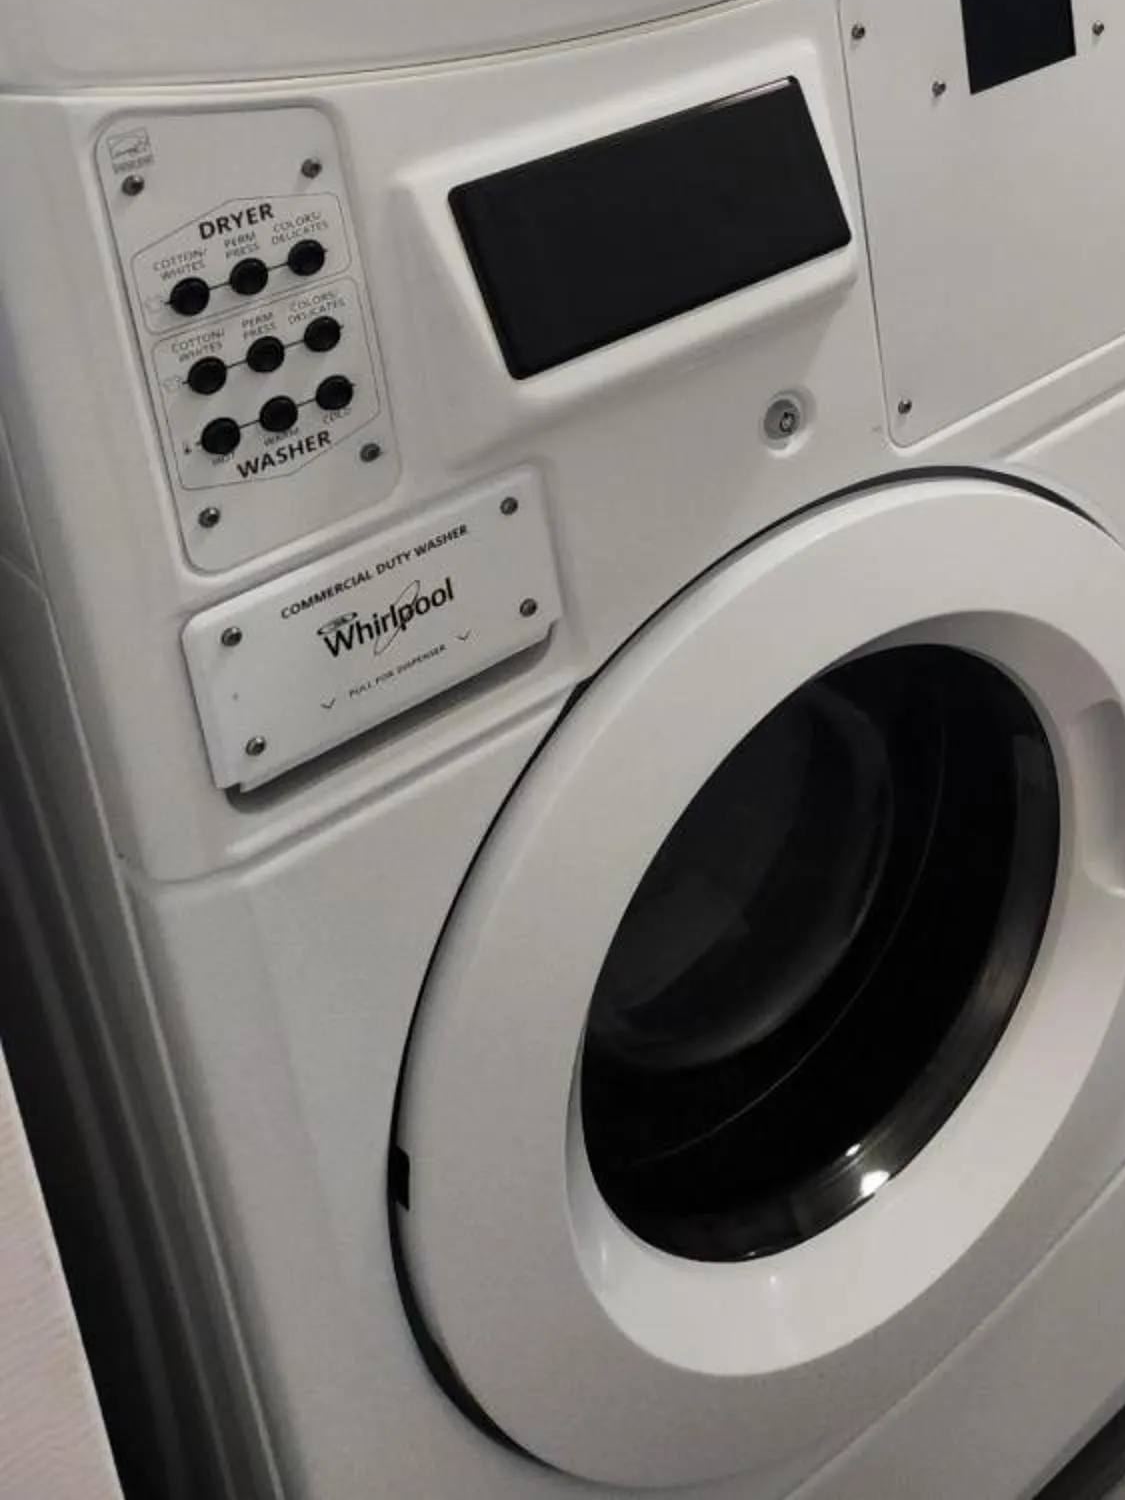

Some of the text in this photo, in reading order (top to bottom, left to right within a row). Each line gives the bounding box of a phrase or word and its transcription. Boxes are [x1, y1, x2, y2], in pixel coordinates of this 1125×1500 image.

[198, 202, 275, 241] DRYER
[223, 231, 256, 249] PERM
[236, 429, 332, 480] WASHER
[280, 524, 467, 620] COMMERCIAL DUTY WASHER
[322, 576, 455, 658] Whirlpool
[349, 644, 447, 699] PULL FOR DISPENSER
